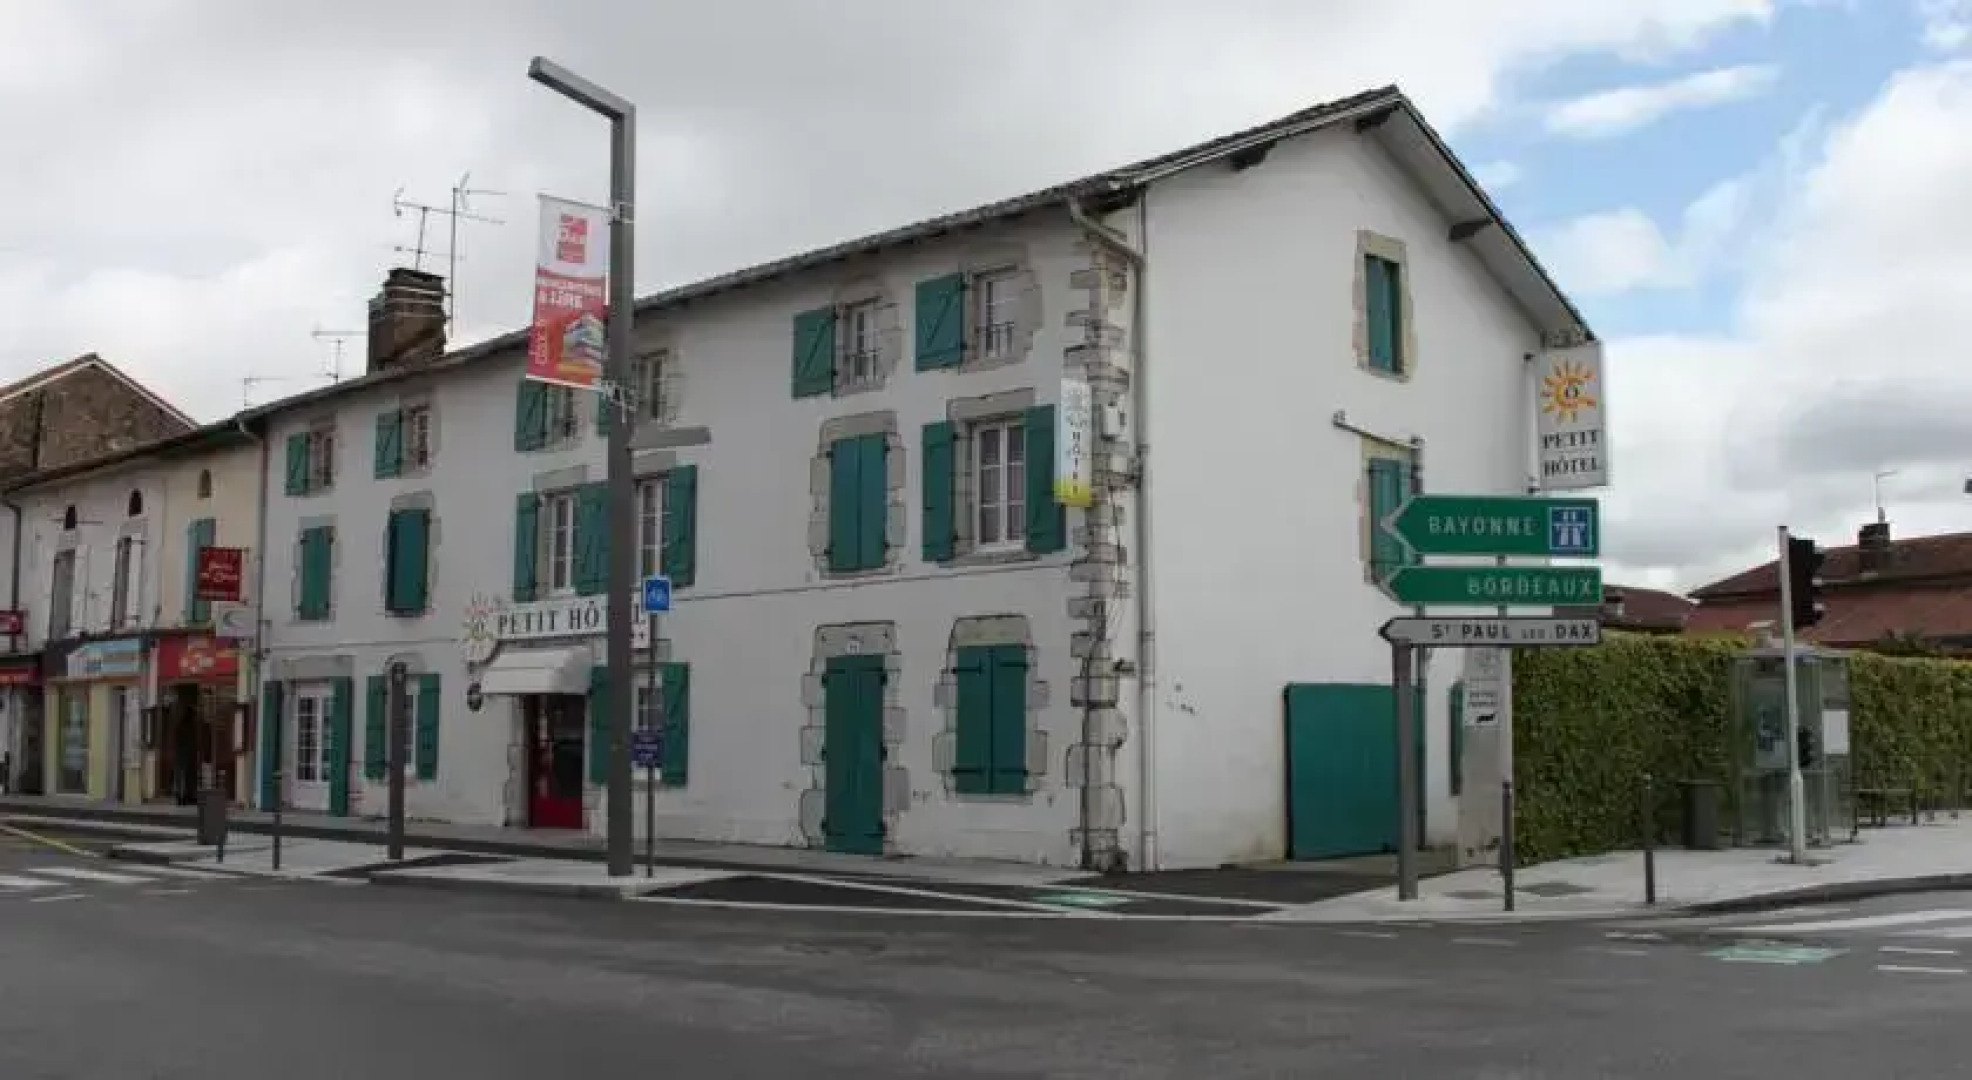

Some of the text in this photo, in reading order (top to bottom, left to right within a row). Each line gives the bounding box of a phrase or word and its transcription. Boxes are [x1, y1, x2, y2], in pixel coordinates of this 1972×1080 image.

[1543, 429, 1598, 450] PETIT
[1543, 455, 1598, 477] HÔTEL
[1429, 515, 1535, 536] BAYONNE
[1467, 575, 1592, 596] BORDEAUX
[499, 609, 557, 635] PETIT
[1462, 623, 1512, 640] PAUL
[1556, 624, 1592, 640] DAX
